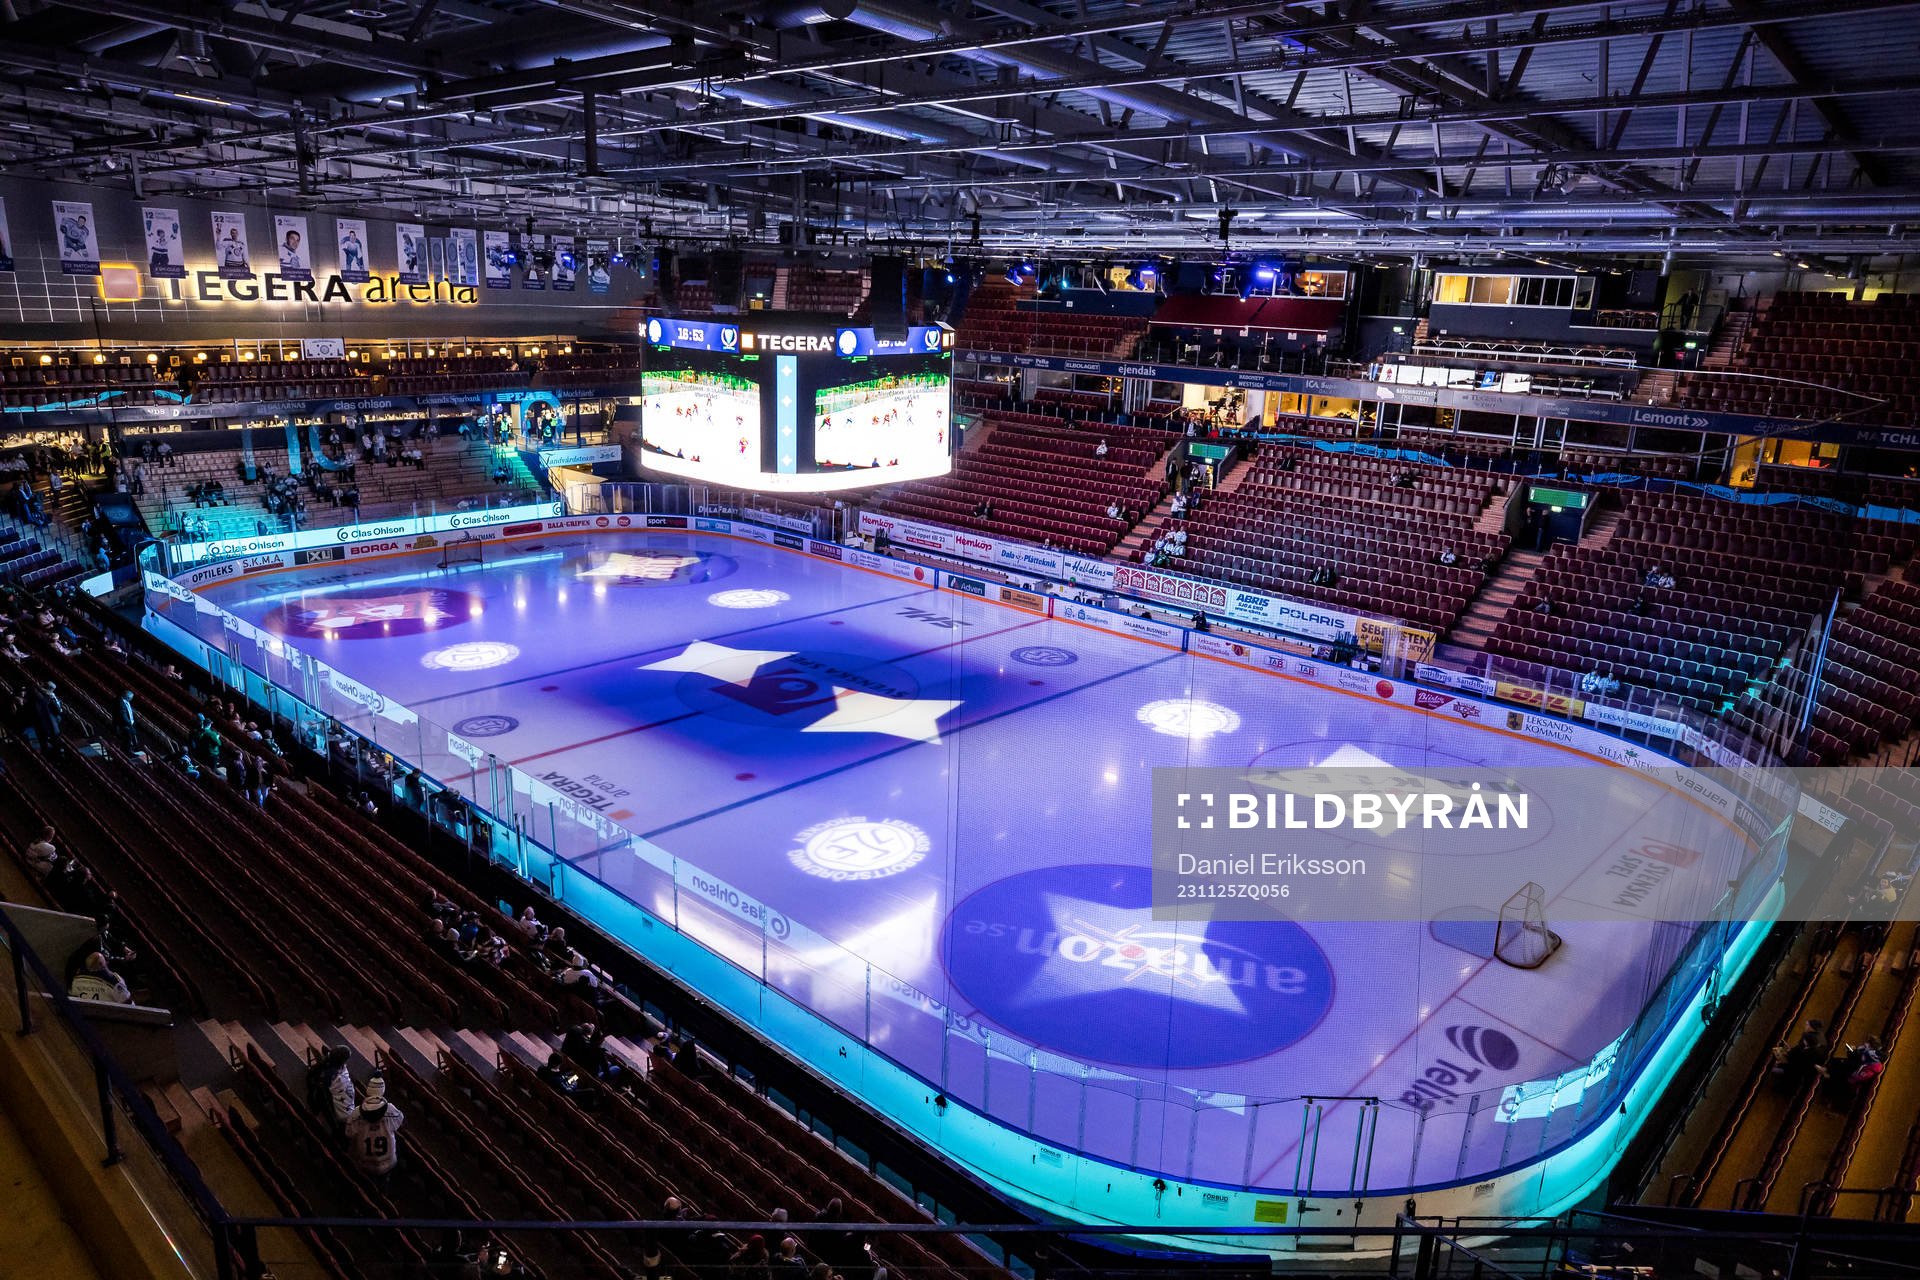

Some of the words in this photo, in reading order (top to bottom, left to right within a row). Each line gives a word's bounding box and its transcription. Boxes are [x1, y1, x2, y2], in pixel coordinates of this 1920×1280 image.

[145, 211, 154, 219] 12
[160, 269, 353, 302] TEGERA
[366, 275, 478, 304] arena
[1118, 364, 1157, 377] ejendals
[334, 401, 357, 410] clas
[358, 399, 392, 409] ohlson
[1634, 410, 1690, 427] Lemont
[462, 516, 481, 526] Clas
[482, 513, 510, 524] Ohlson
[862, 515, 894, 529] Hemköp
[352, 529, 372, 539] Clas
[373, 525, 405, 537] Ohlson
[224, 542, 247, 553] Clas
[249, 539, 285, 552] Ohlson
[350, 542, 398, 556] BORGA
[955, 535, 993, 552] Hemköp
[1001, 549, 1015, 560] Dala
[1024, 554, 1057, 569] Plåtteknik
[192, 564, 234, 584] OPTILEKS
[961, 581, 983, 595] Adven
[1236, 593, 1270, 607] ABRIS
[1280, 607, 1345, 629] POLARIS
[1146, 626, 1169, 637] BUSINESS
[1510, 688, 1569, 711] DHL
[1525, 723, 1573, 743] KOMMUN
[1526, 715, 1574, 735] LEKSANDS
[1598, 744, 1631, 765] SILJAN
[1631, 759, 1661, 777] NEWS
[542, 771, 614, 812] TEGERA
[583, 774, 630, 798] arena
[1684, 779, 1728, 808] BAUER
[1604, 854, 1643, 878] SPEL
[1612, 862, 1671, 908] SVENSKA
[964, 918, 1308, 994] amazon.se
[1400, 1058, 1483, 1112] Telia
[364, 1134, 388, 1158] 19
[1202, 1192, 1229, 1201] FÖRBUD
